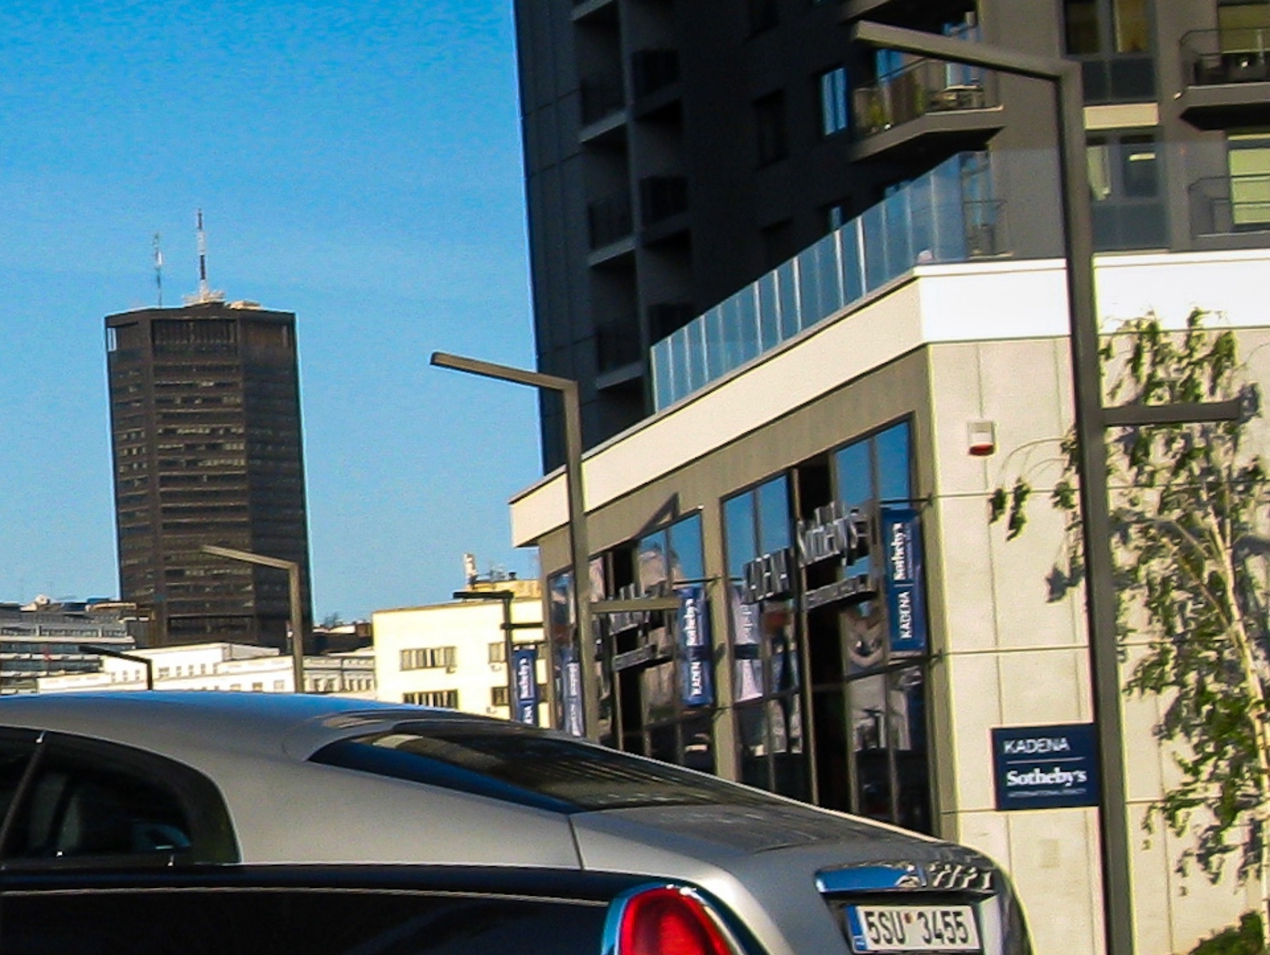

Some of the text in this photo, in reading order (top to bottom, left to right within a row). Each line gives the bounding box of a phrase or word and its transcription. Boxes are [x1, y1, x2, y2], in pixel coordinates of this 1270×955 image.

[891, 523, 907, 580] Sotheby's
[898, 591, 913, 639] KADENA
[1003, 738, 1070, 753] KADENA
[1006, 766, 1087, 786] Sotheby's
[863, 911, 906, 944] 5SU
[917, 911, 969, 944] 3455
